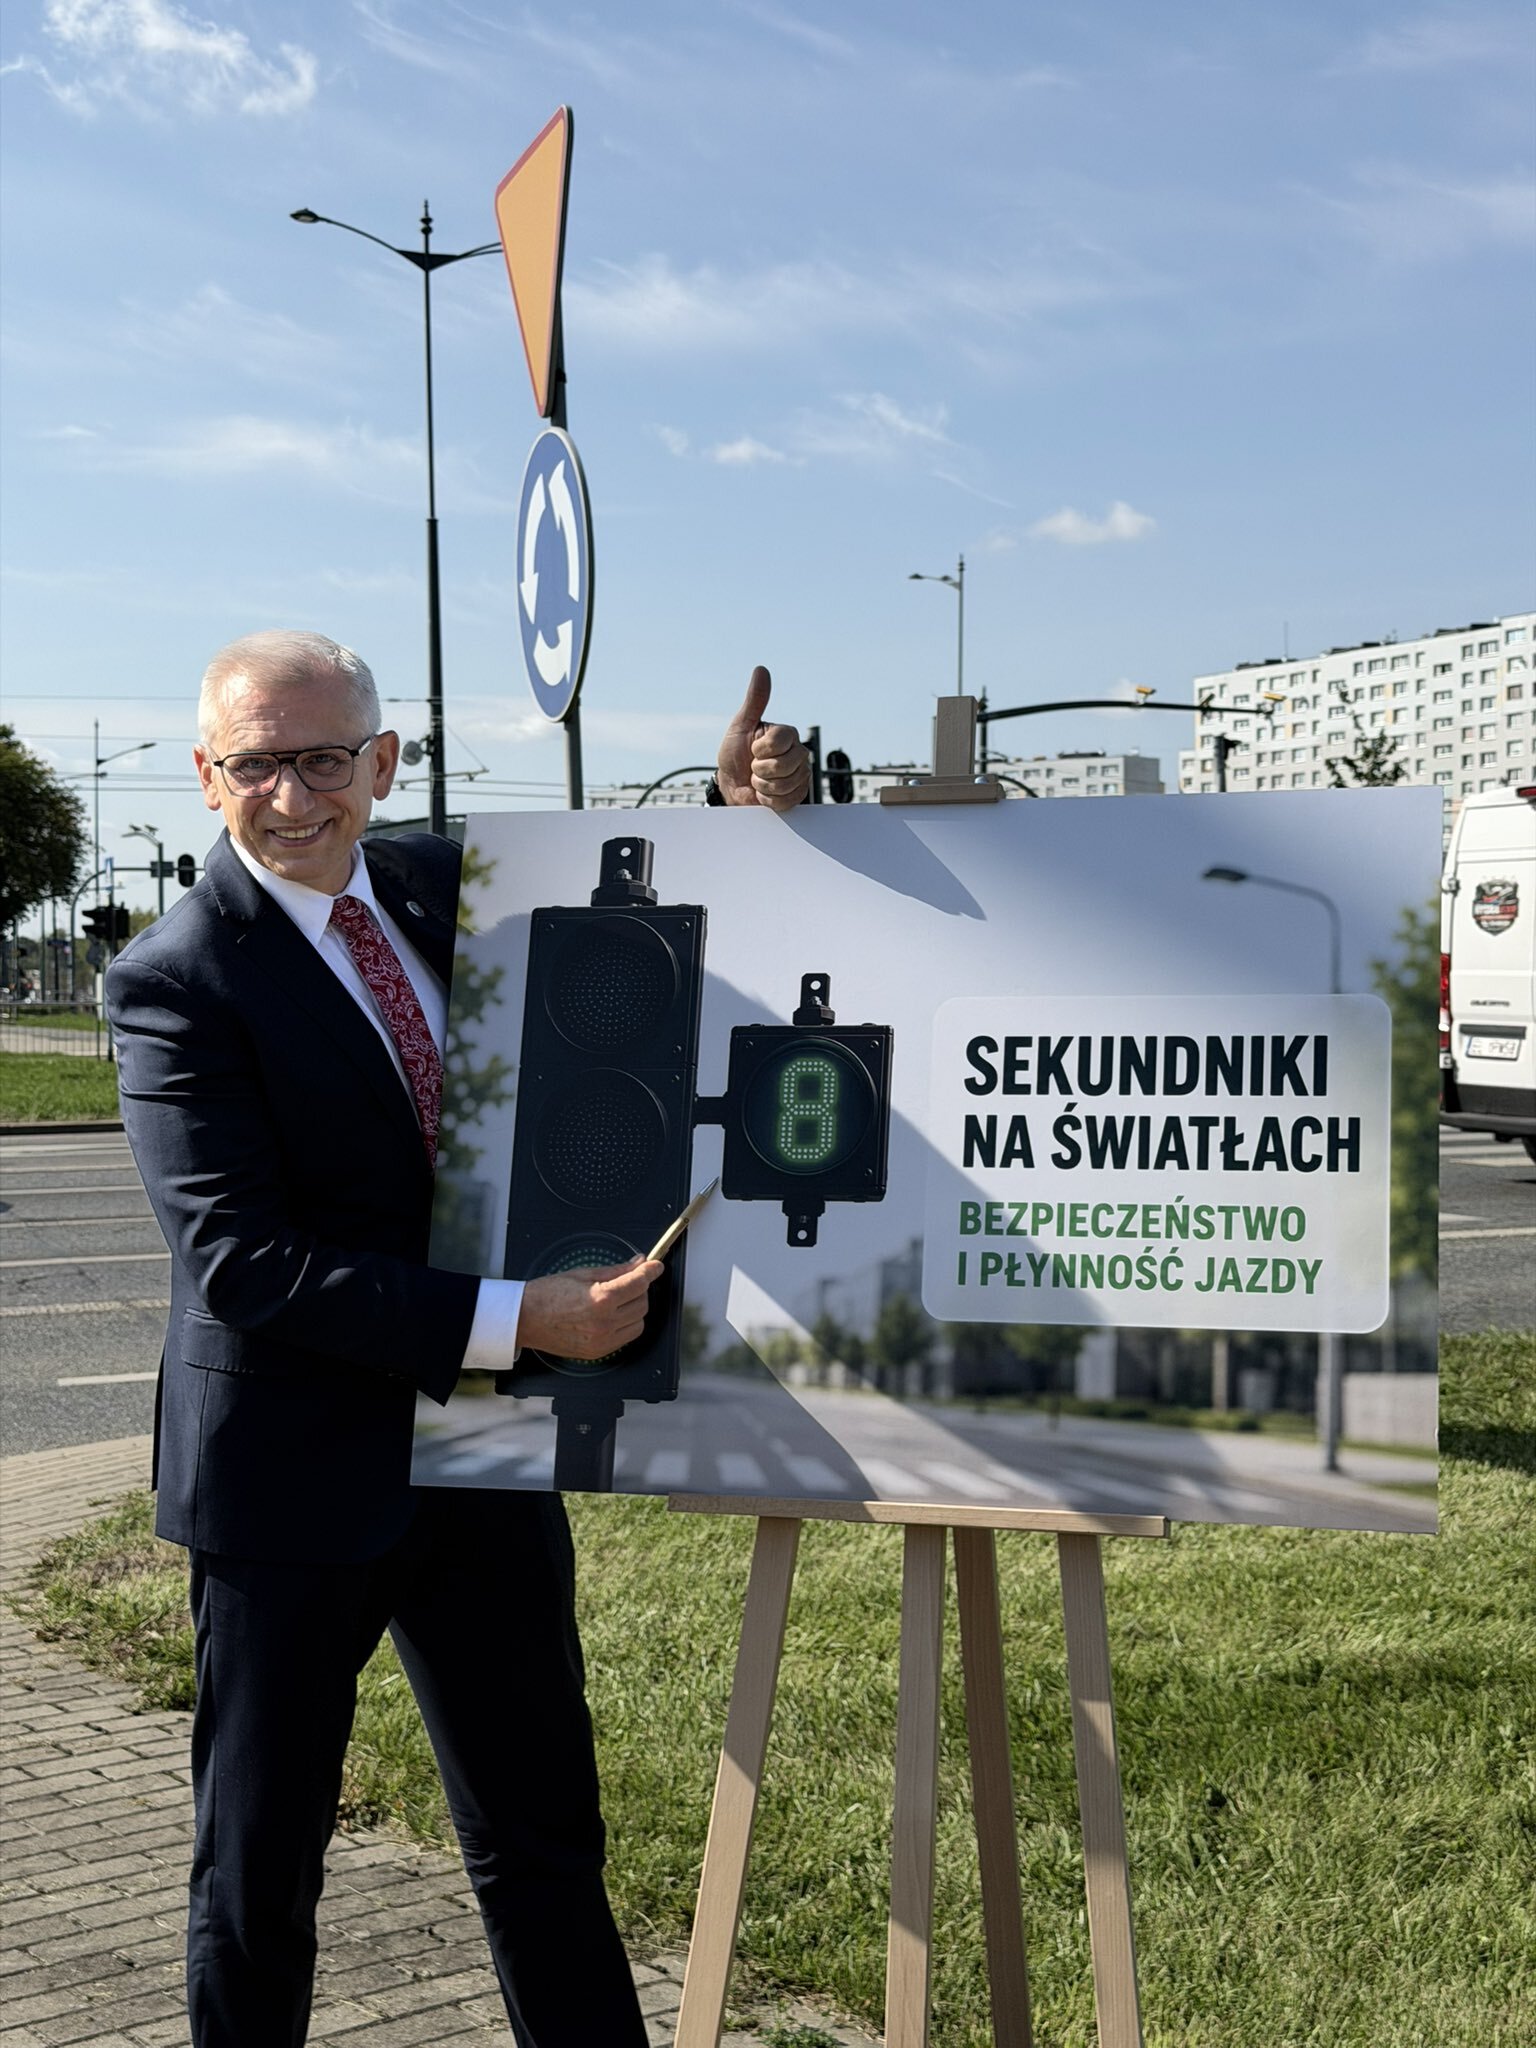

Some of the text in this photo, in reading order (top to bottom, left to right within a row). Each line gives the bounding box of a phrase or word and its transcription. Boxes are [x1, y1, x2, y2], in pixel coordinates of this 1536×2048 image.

[963, 1034, 1329, 1097] SEKUNDNIKI
[780, 1060, 837, 1160] 8
[962, 1102, 1362, 1173] NA ŚWIATŁACH
[958, 1195, 1307, 1243] BEZPIECZEŃSTWO
[957, 1246, 1324, 1296] I PŁYNNOŚĆ JAZDY
